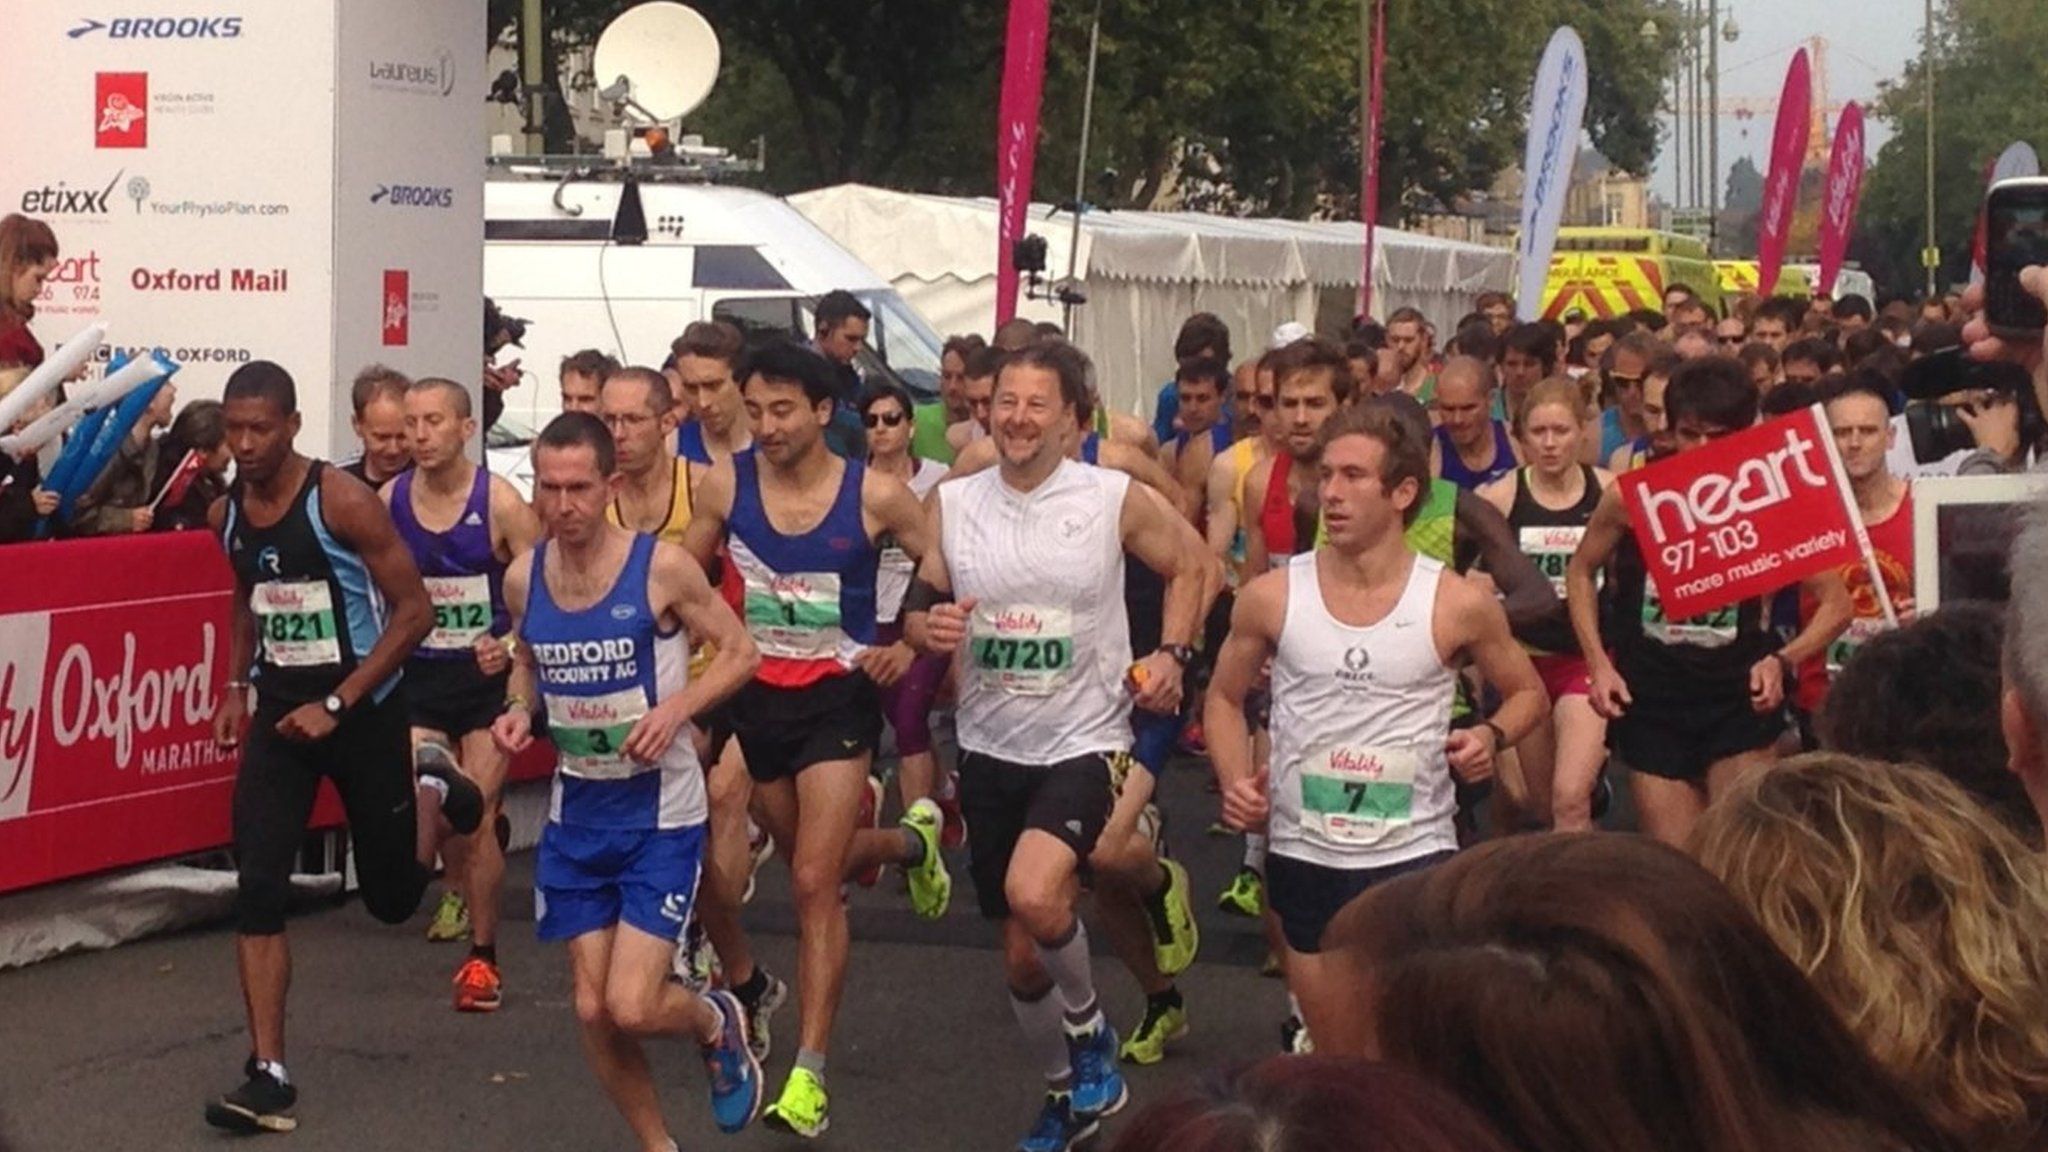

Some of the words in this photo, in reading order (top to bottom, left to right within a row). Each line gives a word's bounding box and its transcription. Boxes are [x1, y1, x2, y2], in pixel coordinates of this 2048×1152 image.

[108, 17, 242, 39] BROOKS
[151, 200, 289, 218] YourPhysioPlan.com
[390, 184, 453, 208] BROOKS
[131, 267, 220, 292] Oxford
[231, 268, 288, 292] Mail
[176, 348, 250, 363] OXFORD
[1637, 428, 1827, 544] heart
[1661, 519, 1759, 575] 97-103
[1674, 572, 1724, 599] more
[1727, 552, 1782, 584] music
[1783, 528, 1847, 563] variety
[781, 602, 796, 626] 1
[982, 638, 1063, 670] 4720
[547, 664, 609, 683] COUNTY
[53, 622, 219, 771] Oxford
[586, 728, 612, 754] 3
[1329, 747, 1384, 780] Vitality
[1343, 781, 1367, 814] 7
